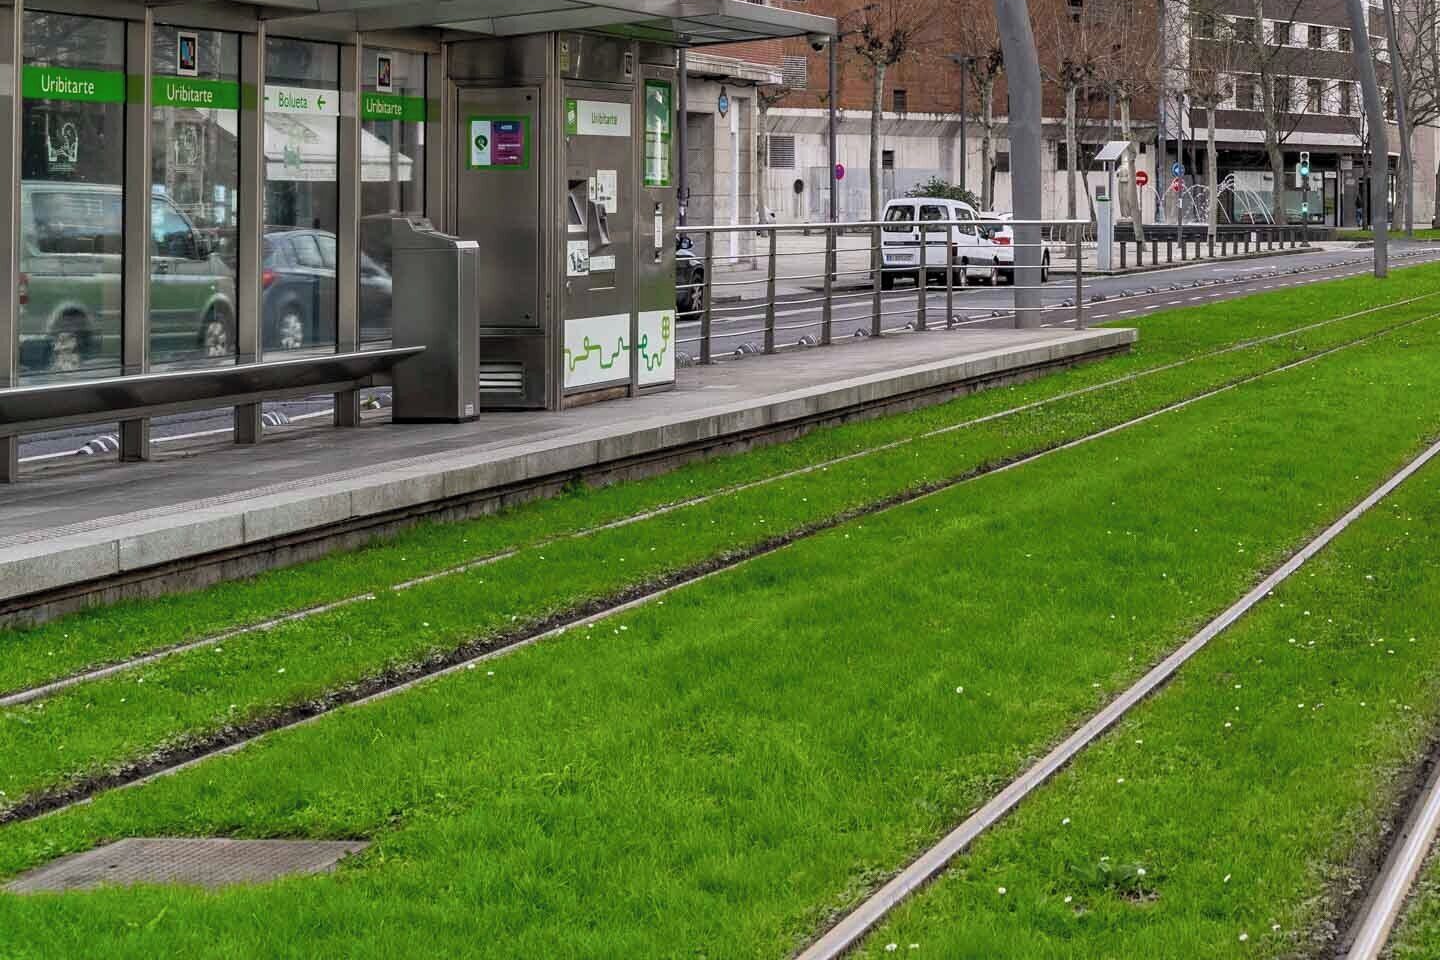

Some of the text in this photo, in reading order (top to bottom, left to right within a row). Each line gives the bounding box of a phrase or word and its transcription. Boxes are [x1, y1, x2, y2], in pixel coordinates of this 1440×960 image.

[41, 74, 95, 94] Uribitarte
[166, 83, 213, 103] Uribitarte
[278, 92, 309, 109] Bolueta
[366, 98, 403, 115] Uribitarte
